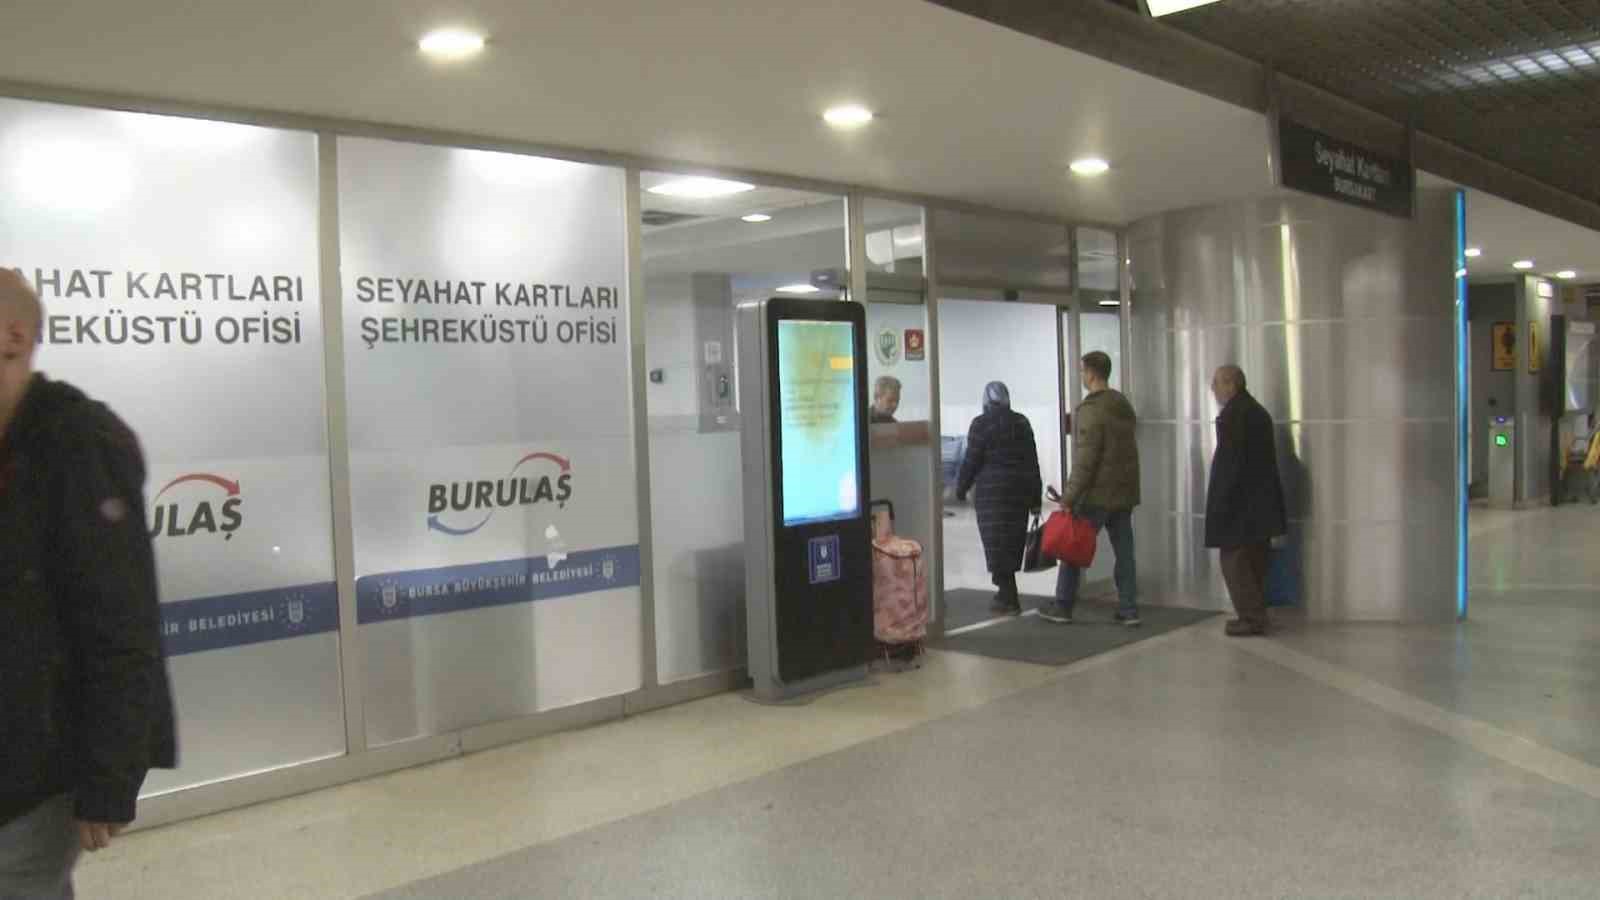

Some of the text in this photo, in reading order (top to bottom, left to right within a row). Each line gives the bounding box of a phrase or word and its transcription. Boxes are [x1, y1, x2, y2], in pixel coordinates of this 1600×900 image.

[127, 271, 304, 301] KARTLARI
[355, 276, 619, 309] SEYAHAT KARTLARI
[37, 308, 302, 345] EKÜSTÜ OFİSİ
[360, 313, 618, 350] ŞEHREKÜSTÜ OFİSİ
[427, 473, 573, 513] BURULAŞ
[407, 582, 449, 599] BURSA
[188, 605, 275, 633] BELEDİYESİ
